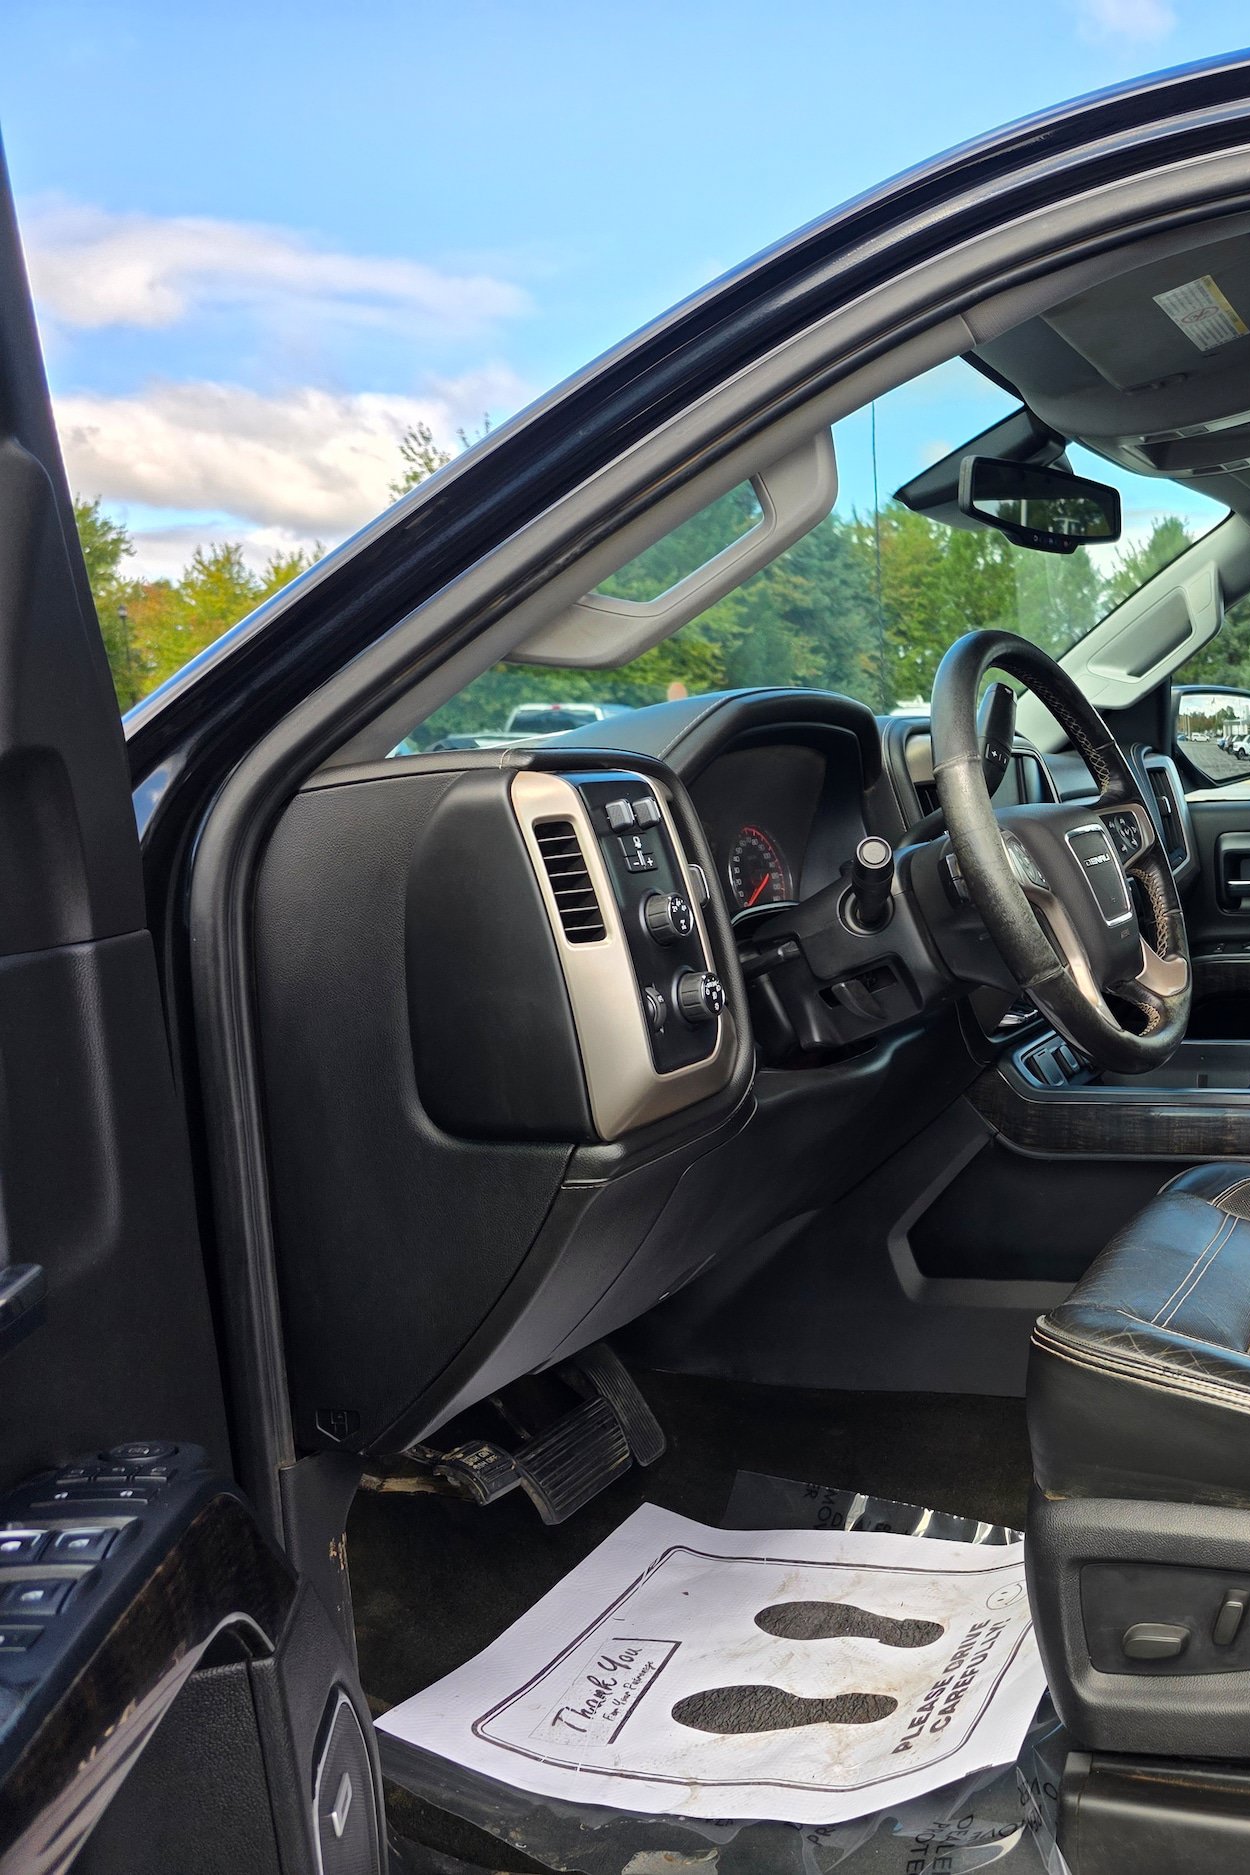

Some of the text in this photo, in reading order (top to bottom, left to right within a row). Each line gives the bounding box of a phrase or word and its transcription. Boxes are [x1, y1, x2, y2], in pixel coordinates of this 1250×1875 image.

[551, 1647, 643, 1733] Thank You
[890, 1618, 991, 1755] PLEASE DRIVE
[929, 1617, 1012, 1734] CAREFULLY!
